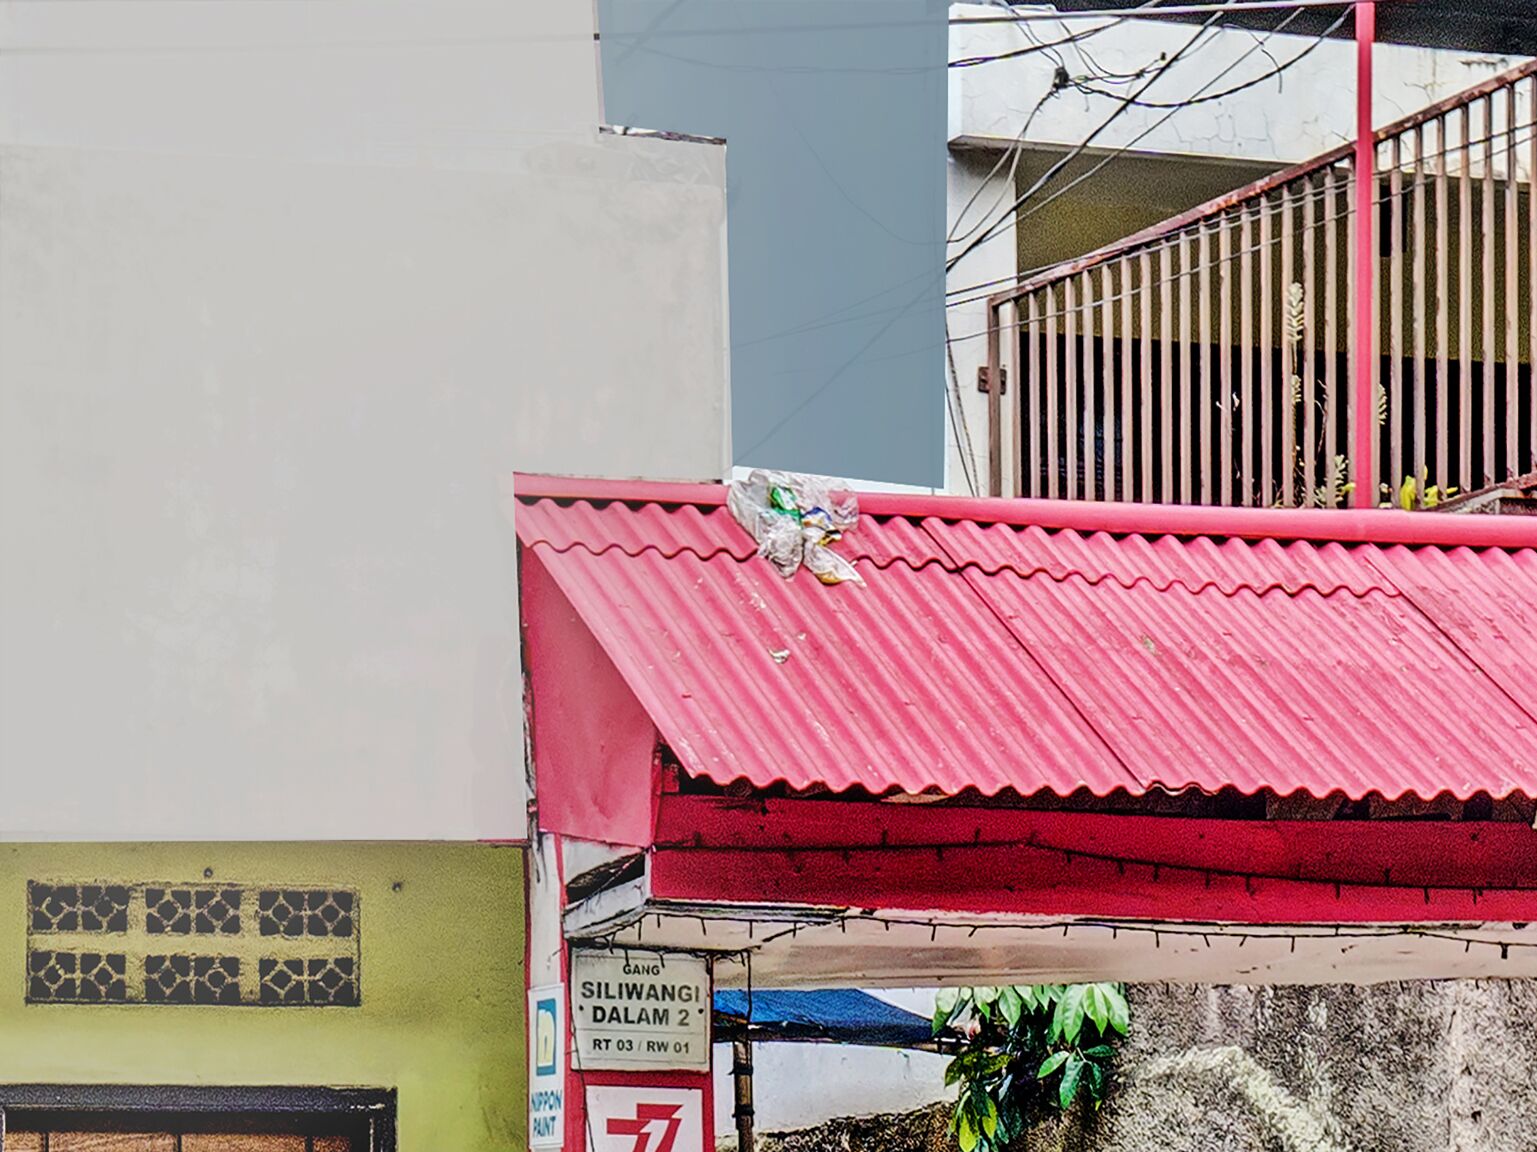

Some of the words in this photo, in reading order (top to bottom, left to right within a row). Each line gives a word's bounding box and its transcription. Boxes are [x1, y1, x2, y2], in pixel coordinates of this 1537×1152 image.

[623, 964, 660, 976] GANG
[581, 981, 699, 1002] SILIWANGI
[593, 1006, 669, 1025] DALAM
[678, 1009, 689, 1026] 2
[593, 1039, 611, 1051] RT
[617, 1039, 633, 1051] 03
[647, 1041, 668, 1052] RW
[674, 1042, 689, 1053] 01
[531, 1090, 562, 1112] NIPPON
[533, 1116, 556, 1137] PAINT
